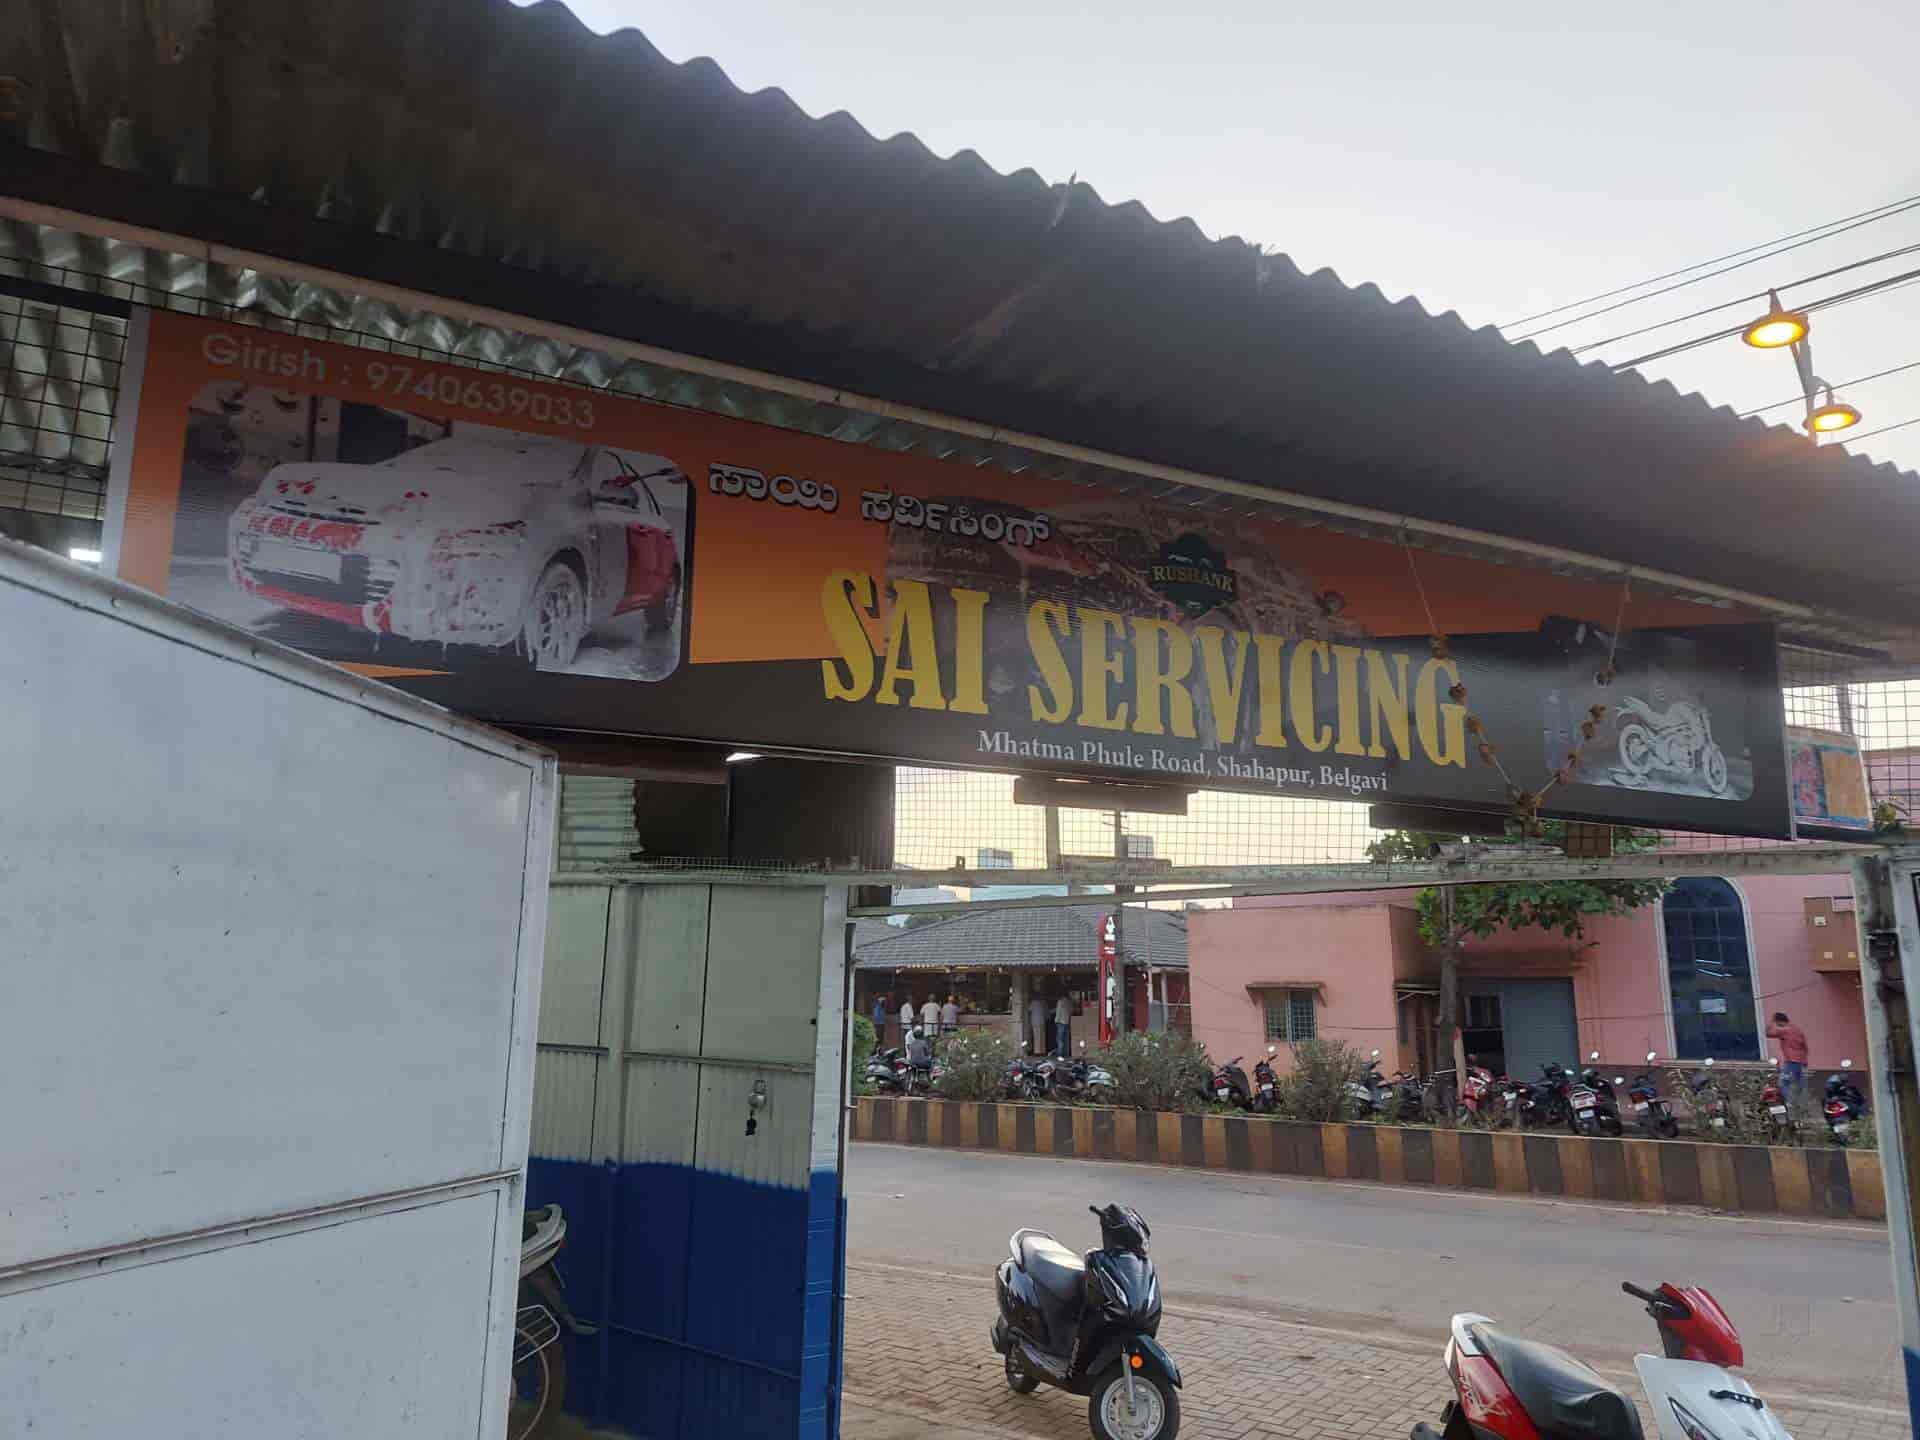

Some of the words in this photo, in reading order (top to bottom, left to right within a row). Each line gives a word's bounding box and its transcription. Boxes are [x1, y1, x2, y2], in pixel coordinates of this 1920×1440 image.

[203, 332, 325, 385] Girish
[366, 361, 594, 430] 9740639033
[708, 462, 840, 512] ಸಾಯಿ
[822, 567, 990, 715] SAI
[1026, 598, 1467, 769] SERVICING
[976, 729, 1075, 761] Mhatma
[1082, 741, 1145, 769] Phule
[1151, 748, 1211, 778] Road,
[1217, 755, 1315, 788] Shahapur,
[1319, 766, 1389, 795] Belgavi
